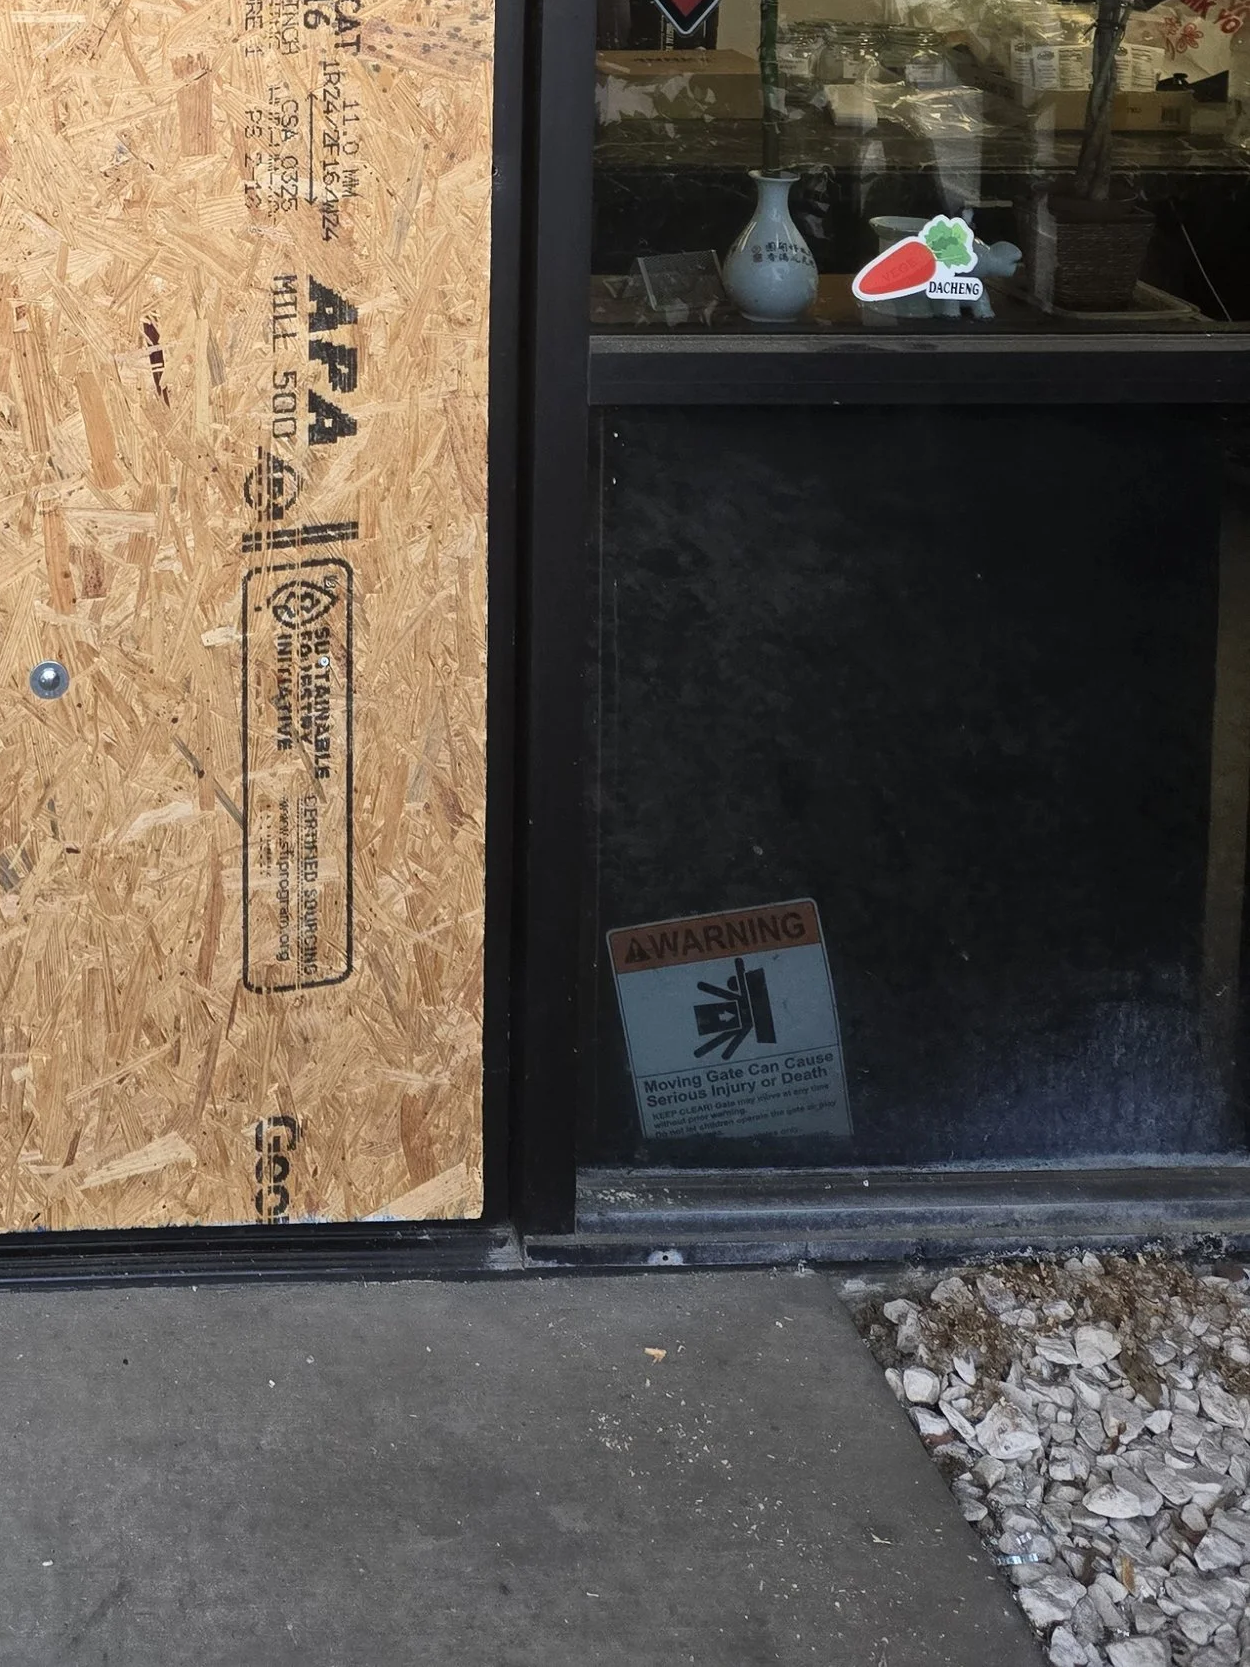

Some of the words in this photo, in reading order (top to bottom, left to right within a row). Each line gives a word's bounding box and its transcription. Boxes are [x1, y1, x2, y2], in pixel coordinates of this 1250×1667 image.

[245, 45, 265, 59] 1
[280, 99, 300, 143] CSA
[341, 99, 360, 157] 11.0
[341, 169, 361, 199] MM
[272, 274, 298, 353] MILL
[928, 280, 981, 296] DACHENG
[308, 274, 359, 446] APA
[272, 370, 298, 438] 500
[276, 632, 294, 751] INITIATIVE
[303, 793, 319, 882] CERTIFIED
[303, 888, 319, 977] SOURCING
[648, 912, 806, 960] WARNING
[643, 1072, 703, 1095] Moving
[706, 1065, 745, 1084] Gate
[748, 1059, 780, 1077] Can
[784, 1051, 835, 1071] Cause
[646, 1089, 708, 1108] Serious
[711, 1080, 757, 1100] Injury
[760, 1074, 779, 1088] or
[781, 1065, 829, 1085] Death
